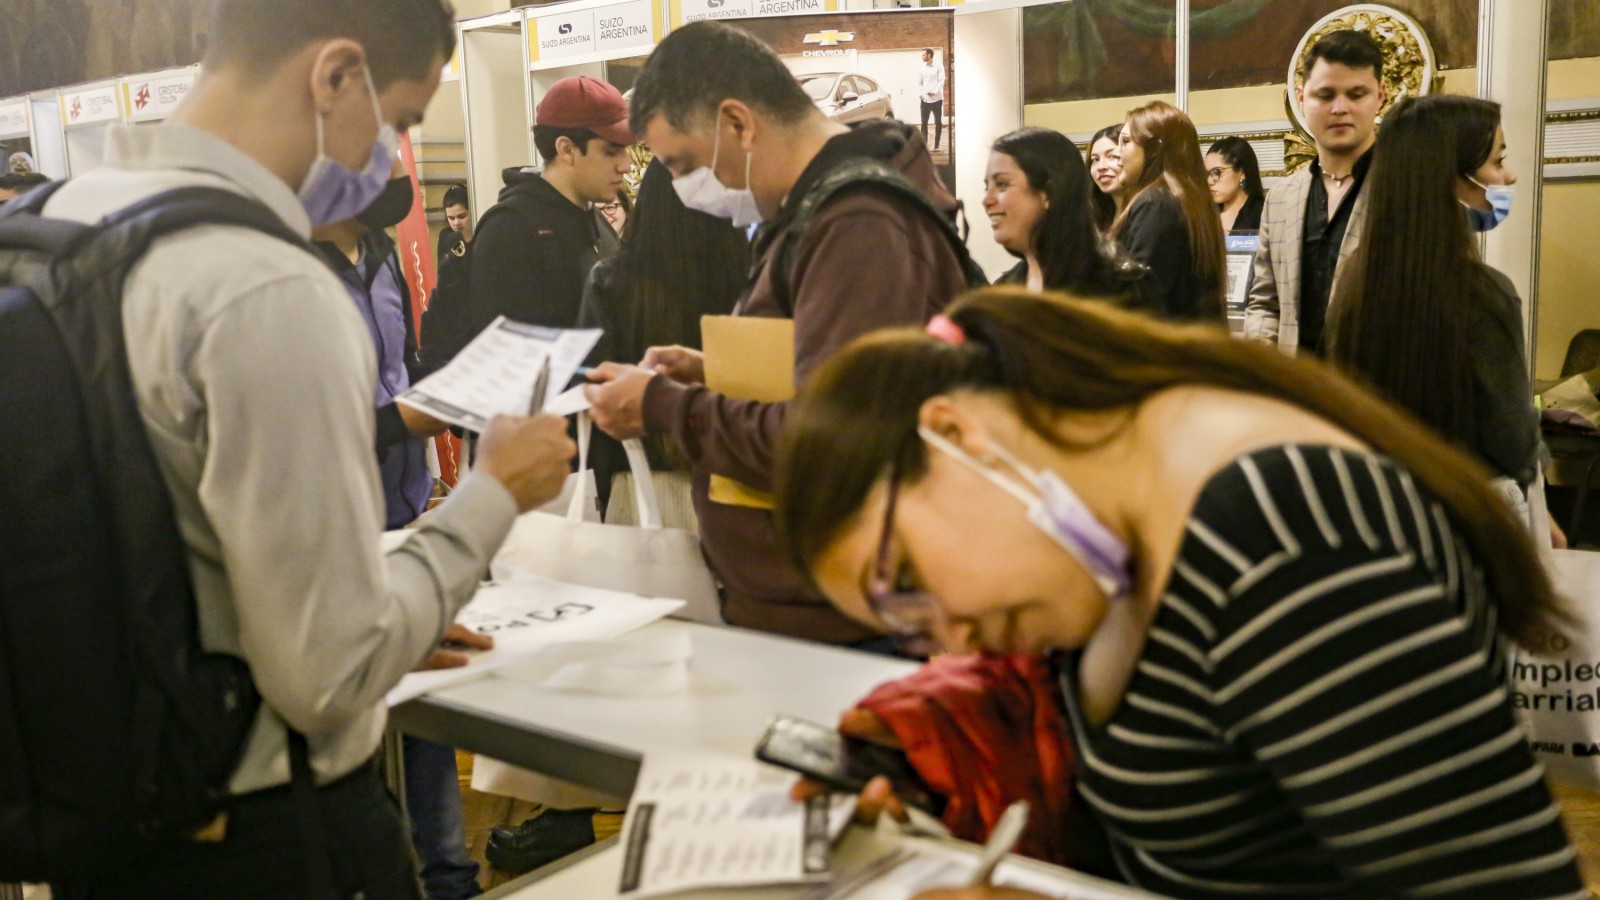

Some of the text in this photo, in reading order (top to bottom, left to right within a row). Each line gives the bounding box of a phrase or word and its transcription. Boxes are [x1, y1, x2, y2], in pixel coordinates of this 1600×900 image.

[759, 0, 819, 15] ARGENTINA
[599, 17, 624, 30] SUIZO
[600, 25, 648, 40] ARGENTINA
[541, 35, 591, 49] SUIZO ARGENTINA
[1511, 659, 1600, 688] mple
[1512, 688, 1600, 712] arrial
